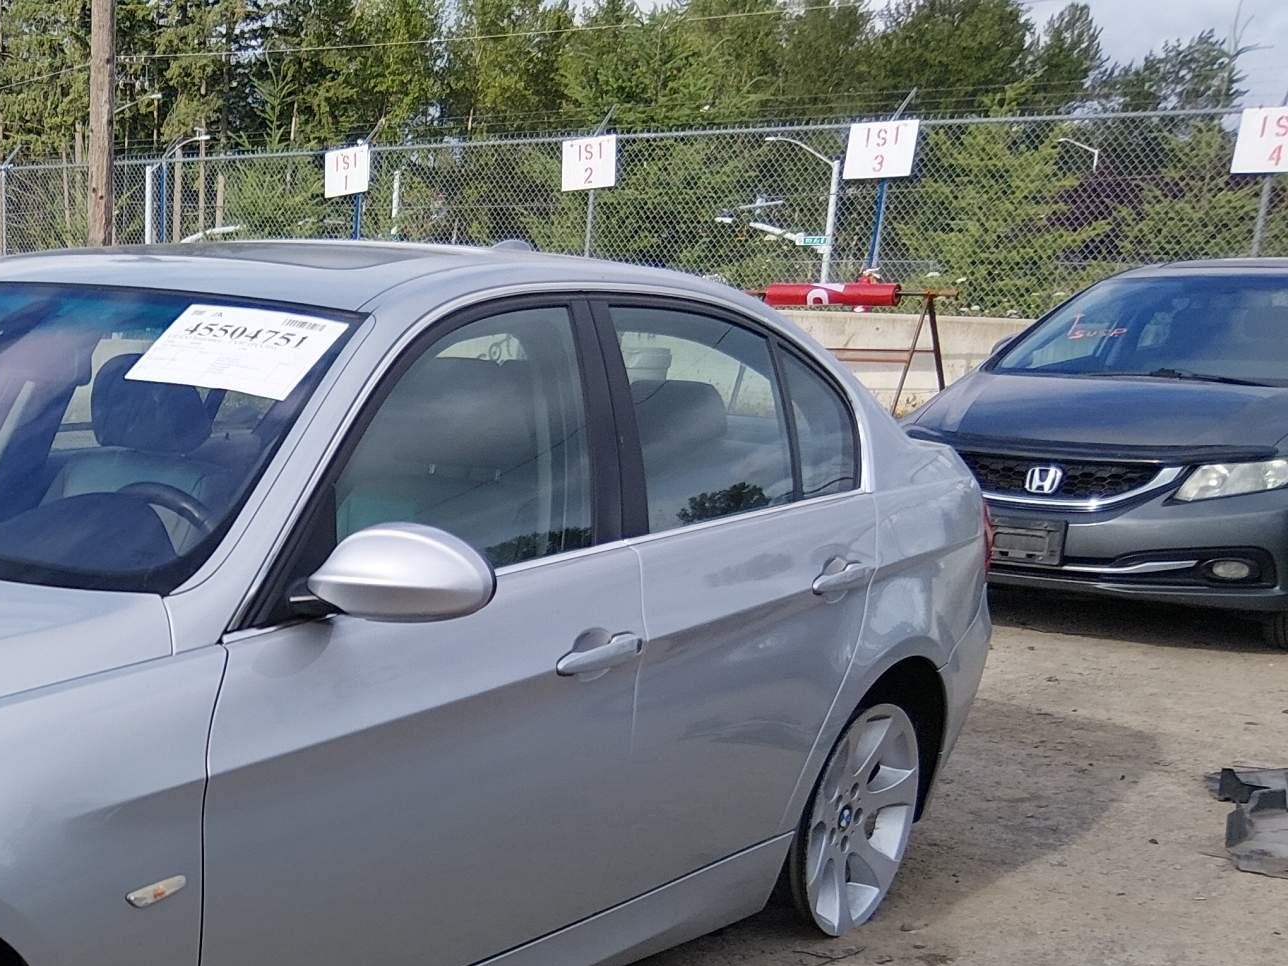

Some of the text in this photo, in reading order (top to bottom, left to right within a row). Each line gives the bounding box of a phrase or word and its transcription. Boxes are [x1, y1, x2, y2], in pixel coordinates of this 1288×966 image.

[872, 154, 885, 172] 3
[1268, 145, 1283, 166] 4
[583, 167, 593, 184] 2
[184, 322, 309, 348] 45504751
